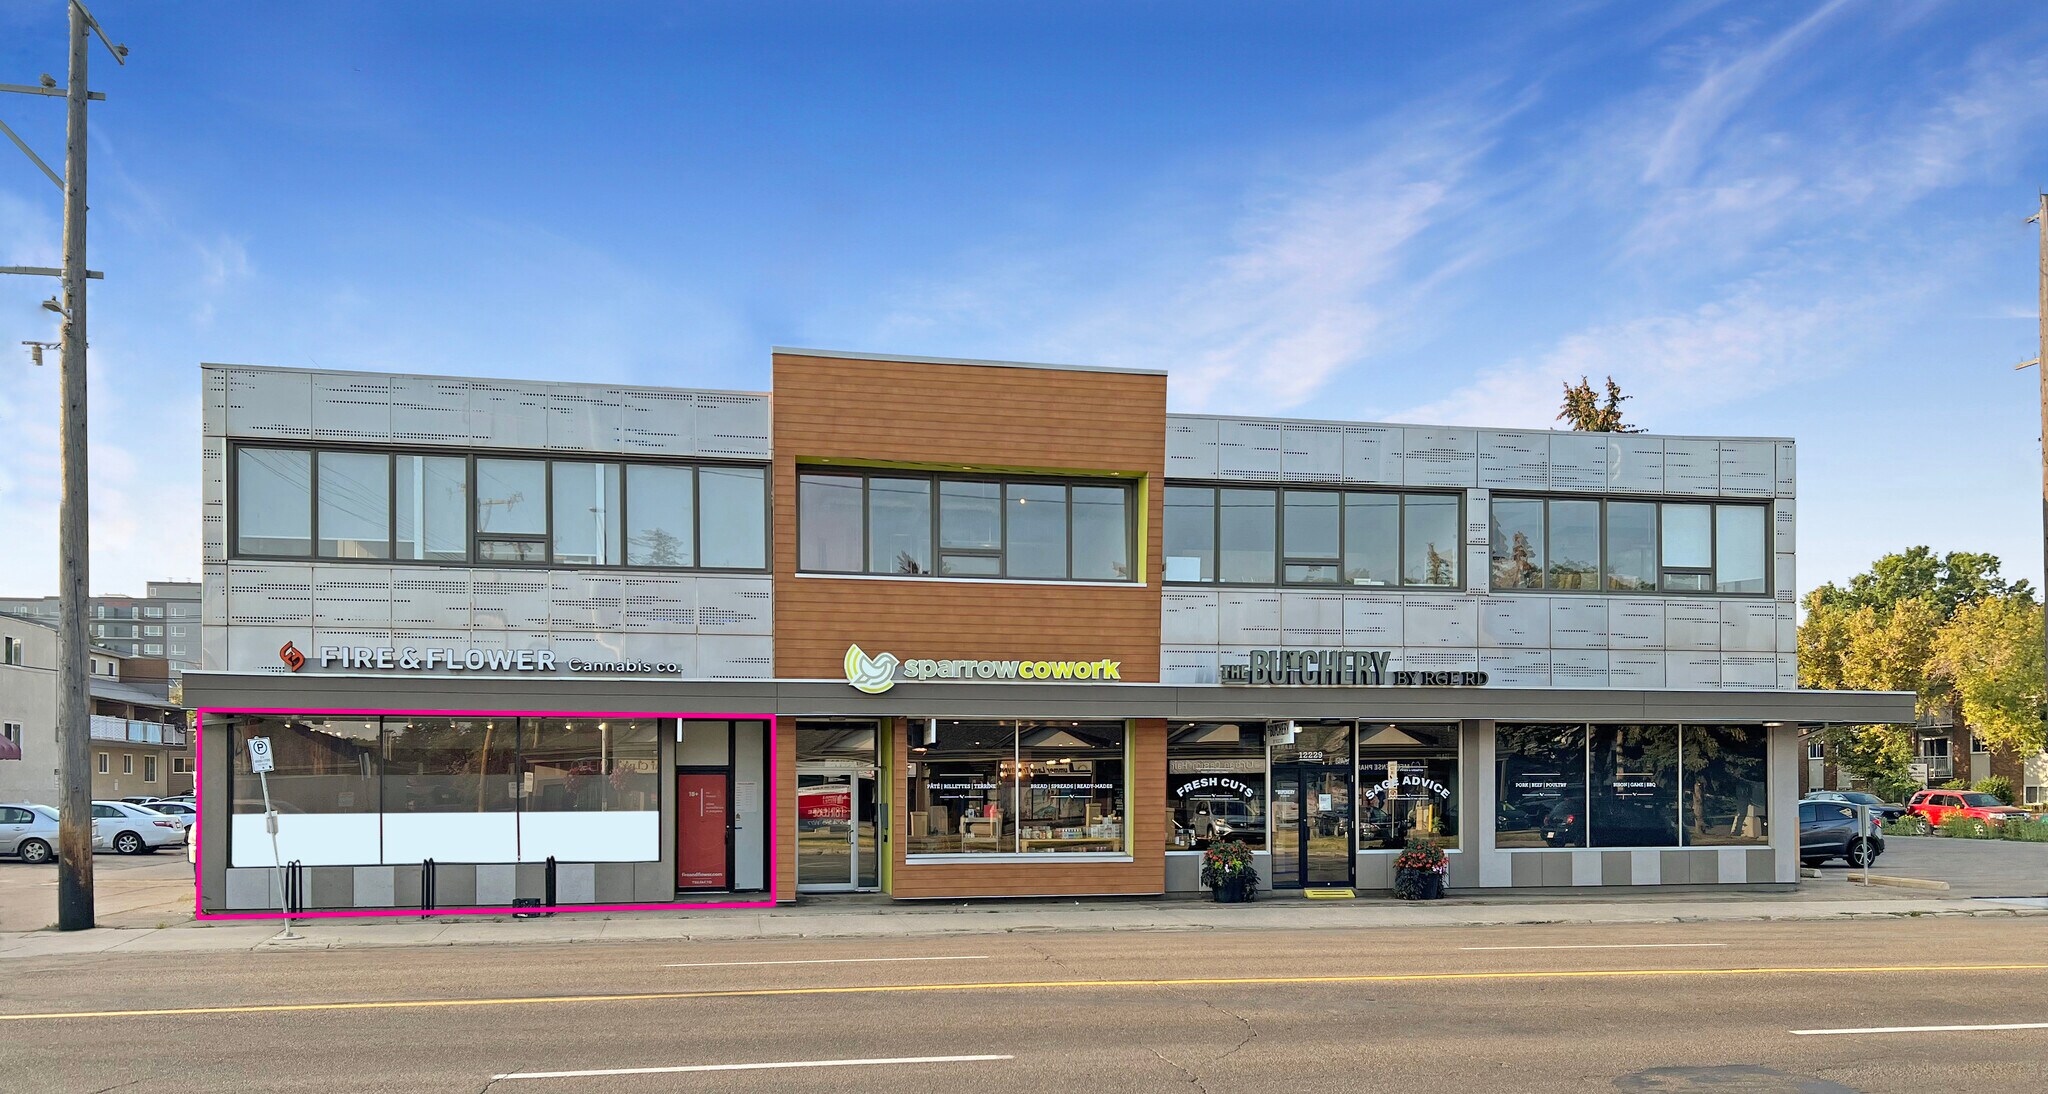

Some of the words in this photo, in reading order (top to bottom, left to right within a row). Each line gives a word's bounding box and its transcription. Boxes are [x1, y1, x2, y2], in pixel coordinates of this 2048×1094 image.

[568, 657, 652, 673] Cannabis
[656, 662, 683, 673] co.
[903, 658, 1122, 682] sparrowcowork
[1221, 664, 1249, 684] THE
[1250, 650, 1391, 686] BUTCHERY
[1394, 671, 1420, 687] BY
[1421, 671, 1460, 687] RGE
[1461, 671, 1490, 687] RD
[1299, 751, 1323, 759] 12229
[1176, 777, 1218, 798] FRESH
[1220, 778, 1254, 798] CUTS
[1365, 777, 1400, 800] SAGE
[1402, 776, 1451, 799] ADVICE
